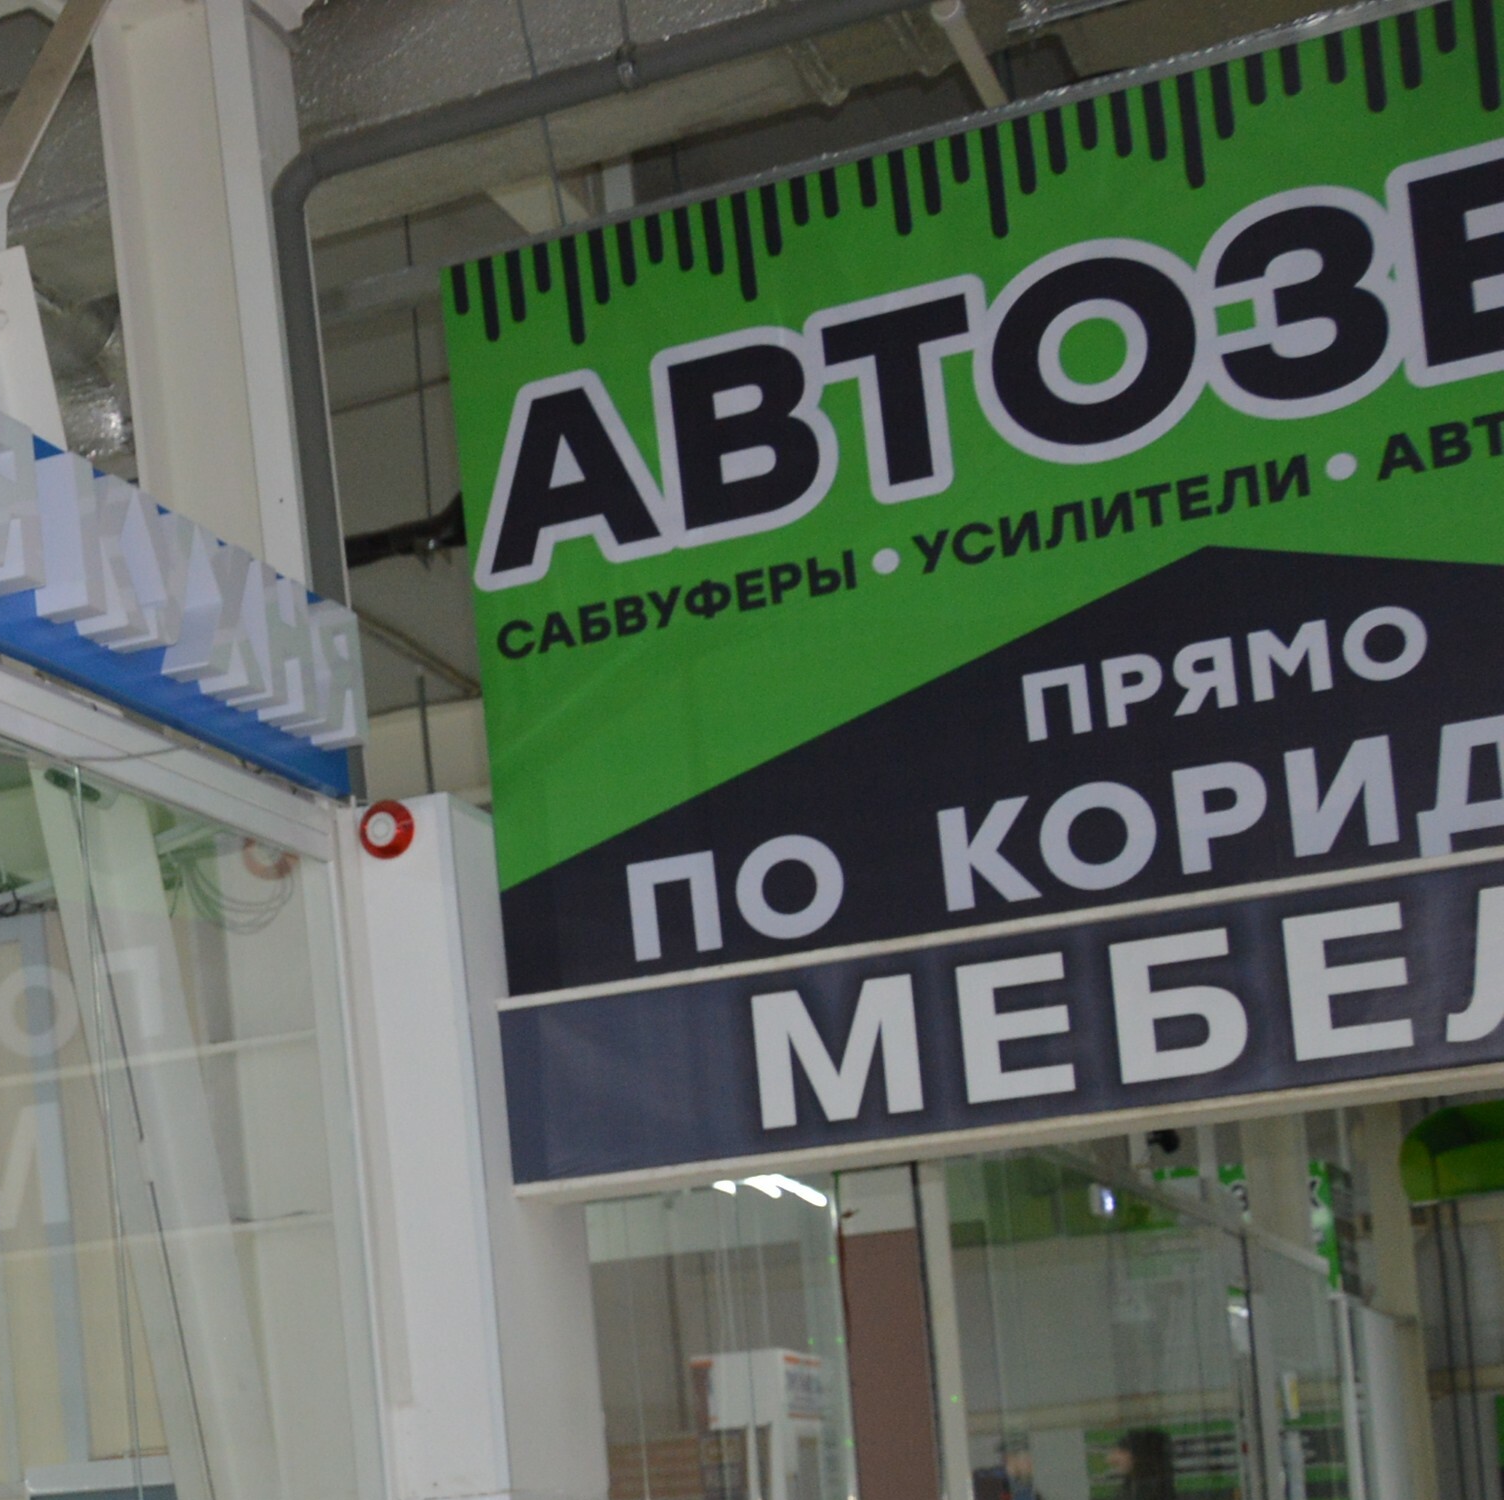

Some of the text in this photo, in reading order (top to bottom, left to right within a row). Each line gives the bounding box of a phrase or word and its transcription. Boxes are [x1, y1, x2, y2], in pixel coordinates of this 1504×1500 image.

[34, 451, 367, 749] КУХНЯ
[496, 551, 857, 661] САБВУФЕРЫ
[911, 454, 1311, 574] УСИЛИТЕЛИ
[1022, 605, 1428, 744] ПРЯМО
[626, 714, 1504, 963] ПО КОРИД
